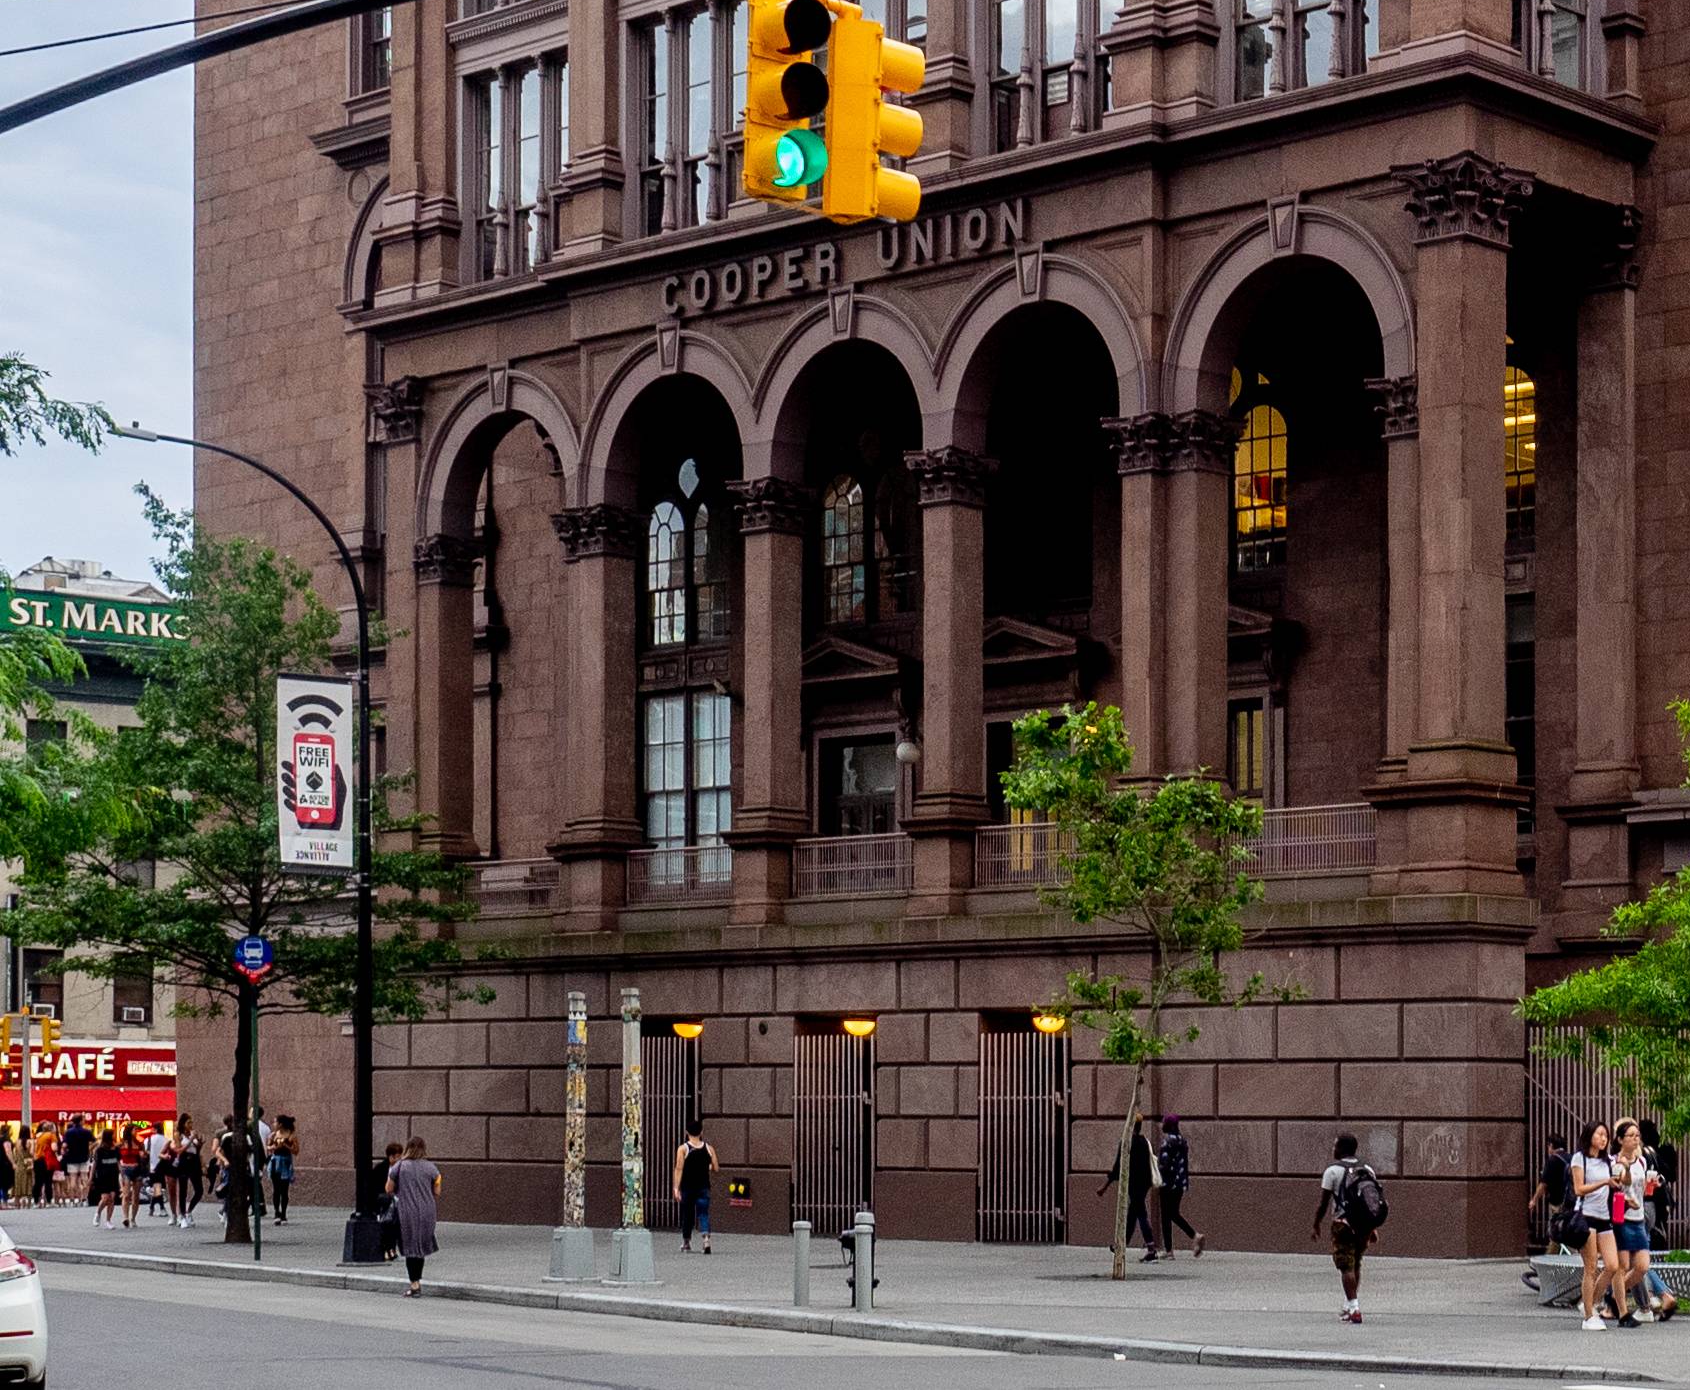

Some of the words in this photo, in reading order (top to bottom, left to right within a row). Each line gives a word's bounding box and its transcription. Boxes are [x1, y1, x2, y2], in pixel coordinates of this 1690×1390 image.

[661, 242, 838, 315] COOPER
[876, 197, 1024, 270] UNION
[9, 598, 54, 627] ST.
[62, 600, 191, 640] MARKS
[298, 746, 329, 757] FREE
[299, 756, 329, 768] WIFI
[309, 842, 338, 852] VILLAGE
[30, 1047, 116, 1080] CAFÉ
[96, 1111, 131, 1121] PIZZA
